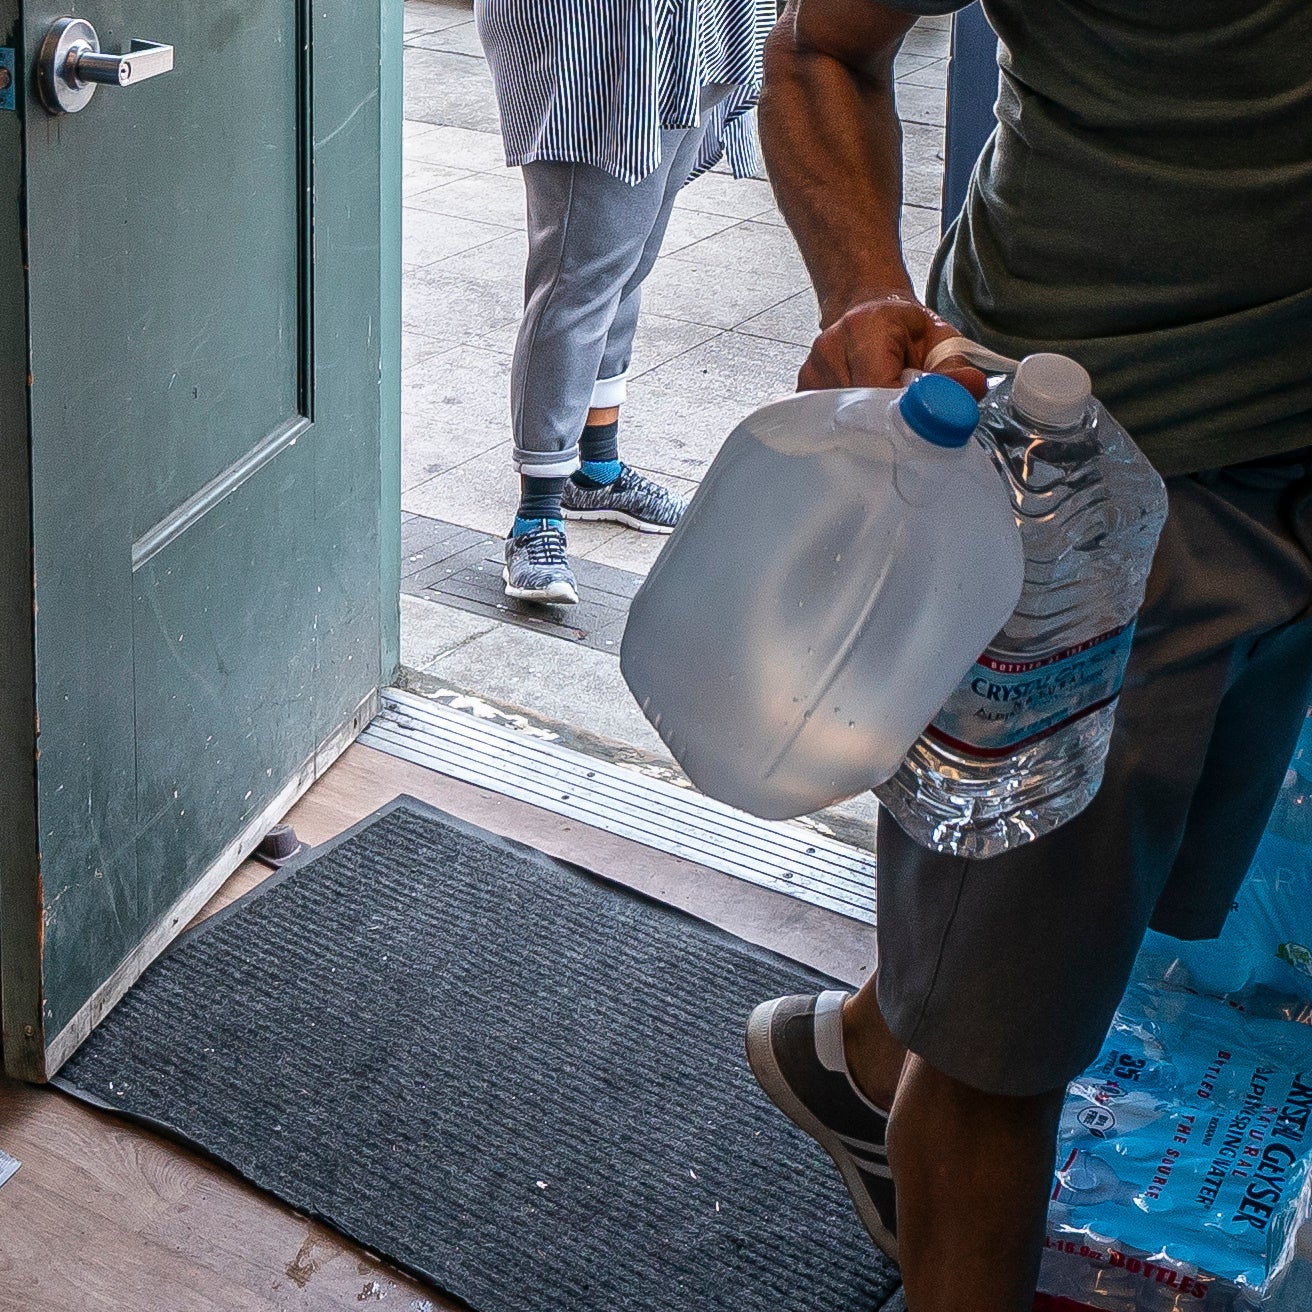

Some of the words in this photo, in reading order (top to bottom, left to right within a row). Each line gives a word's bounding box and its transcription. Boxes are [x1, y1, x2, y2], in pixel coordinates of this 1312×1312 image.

[1113, 1052, 1147, 1083] 35
[1172, 1114, 1196, 1145] THE
[1232, 1142, 1297, 1232] GEYSER
[1108, 1249, 1210, 1300] BOTTLES
